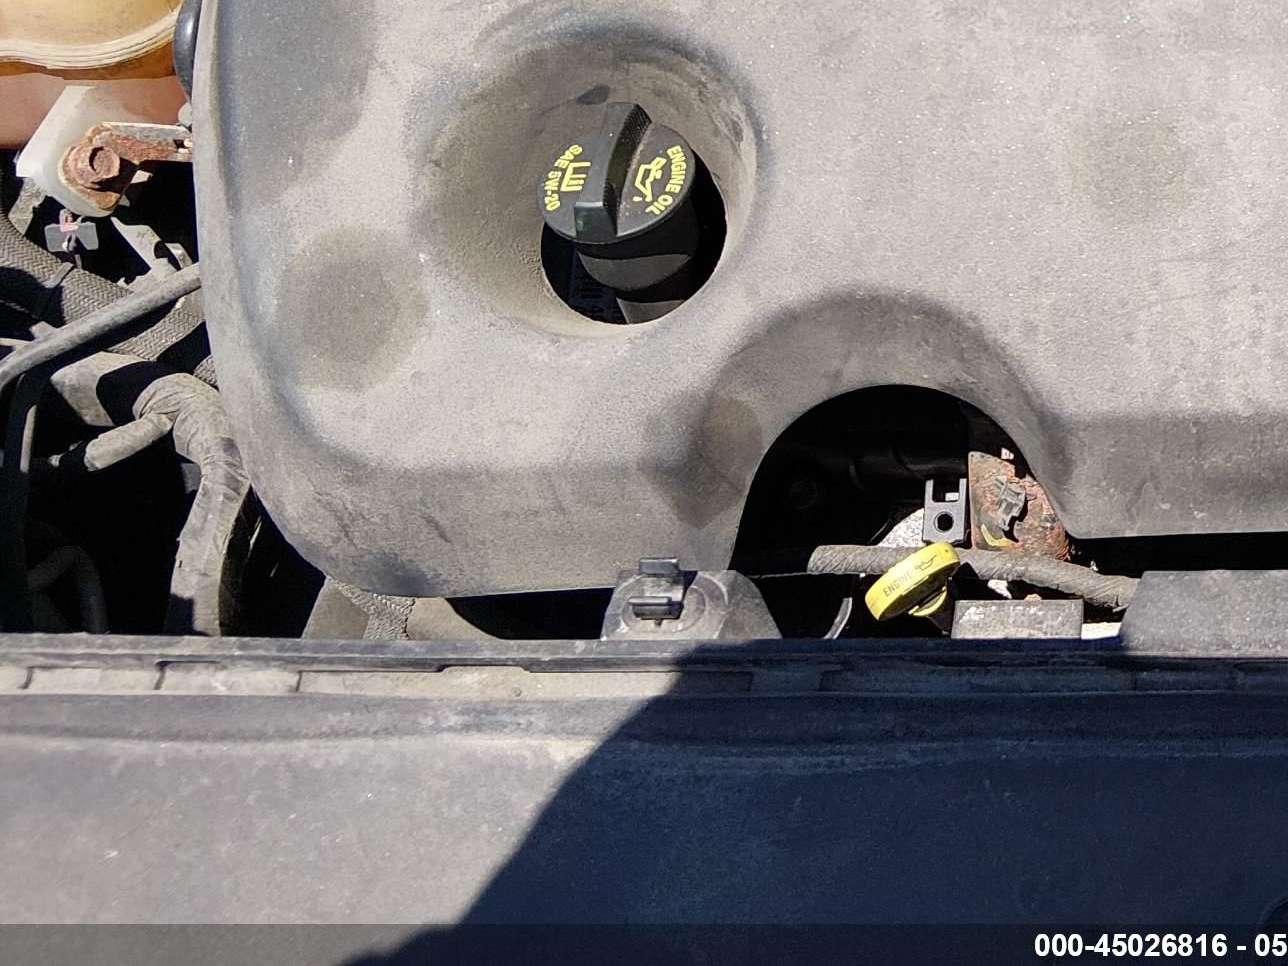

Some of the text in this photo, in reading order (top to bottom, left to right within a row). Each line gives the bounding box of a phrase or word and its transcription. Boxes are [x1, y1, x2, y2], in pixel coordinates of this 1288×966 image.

[543, 144, 583, 212] SAE 5W-20
[645, 144, 688, 216] ENGINE OIL
